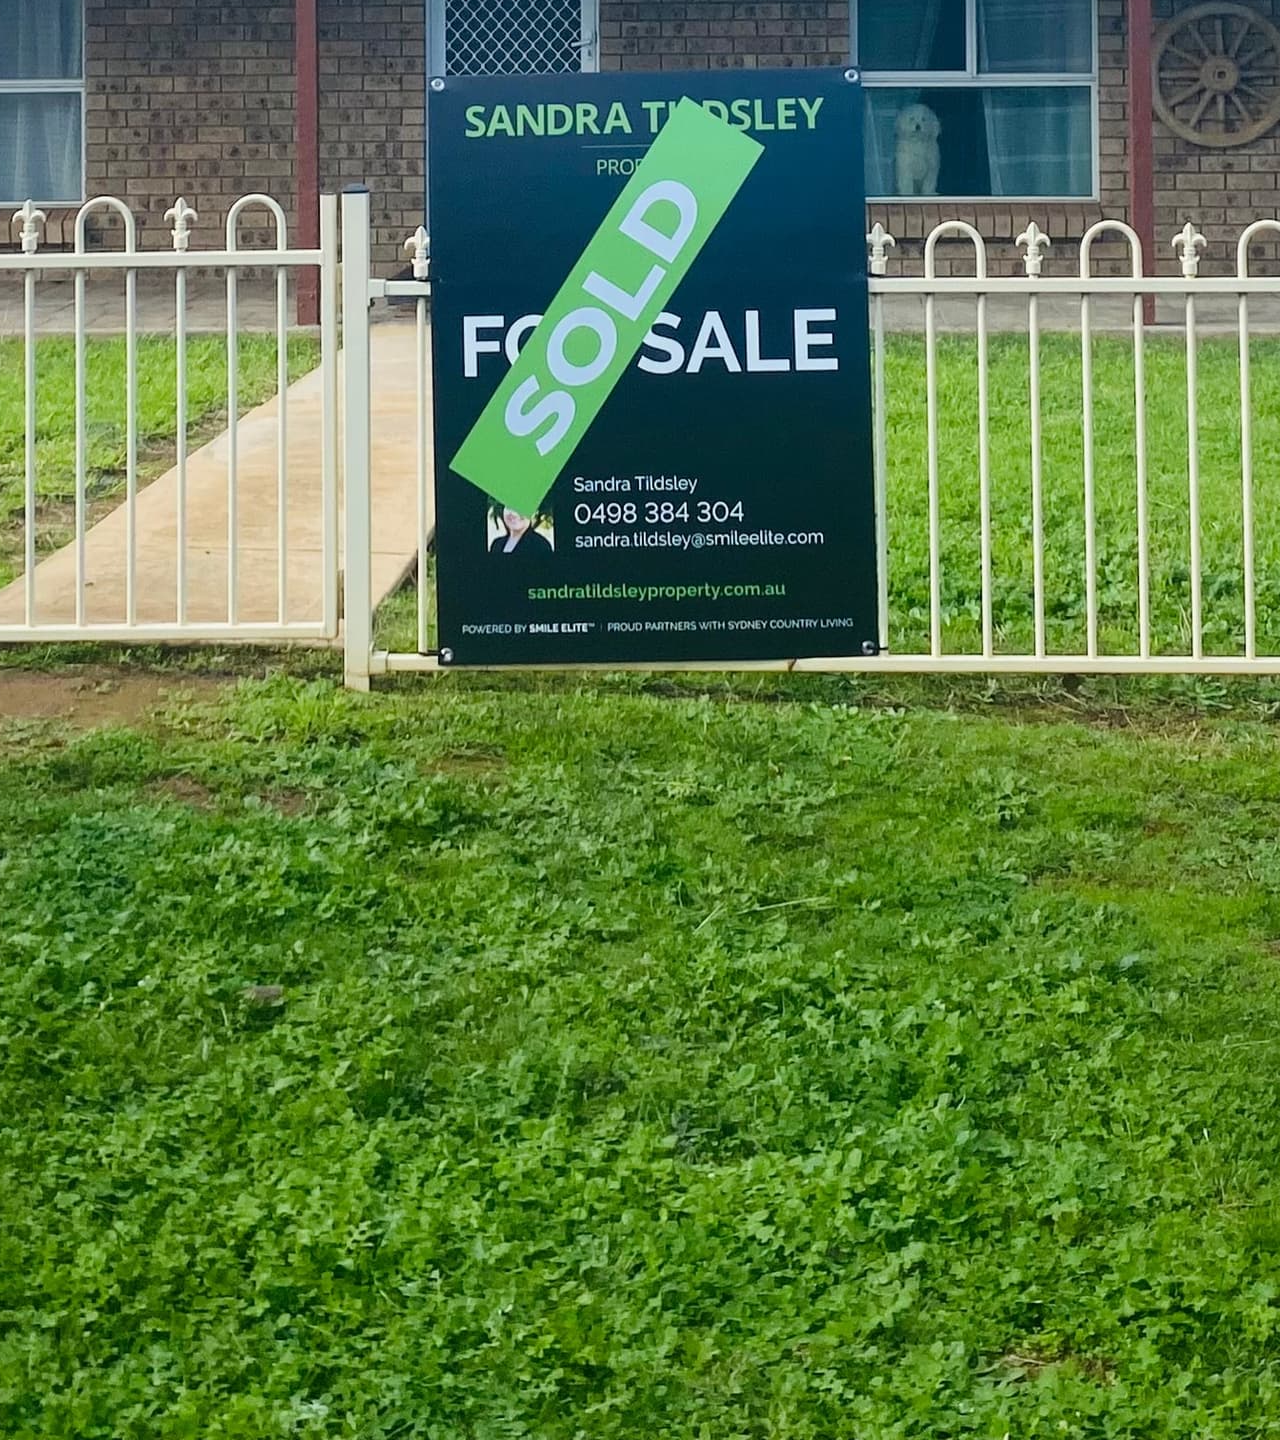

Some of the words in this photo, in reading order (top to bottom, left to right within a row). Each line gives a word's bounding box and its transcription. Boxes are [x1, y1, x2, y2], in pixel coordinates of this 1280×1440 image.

[464, 100, 632, 138] SANDRA
[642, 96, 824, 134] TDSLEY
[504, 180, 698, 456] SOLD
[637, 308, 838, 374] SALE
[574, 475, 631, 493] Sandra
[634, 474, 698, 495] Tildsley
[574, 502, 638, 525] 0498
[645, 501, 690, 524] 384
[696, 500, 744, 523] 304
[575, 529, 825, 550] sandra.tildsley@smileelite.com
[527, 581, 786, 601] sandratildsleyproperty.com.au
[462, 624, 512, 634] POWERED
[514, 624, 527, 634] BY
[529, 623, 559, 634] SMILE
[607, 621, 642, 632] PROUD
[644, 621, 697, 632] PARTNERS
[698, 620, 725, 630] WITH
[727, 619, 768, 630] SYDNEY
[769, 618, 817, 629] COUNTRY
[819, 617, 854, 628] LIVING
